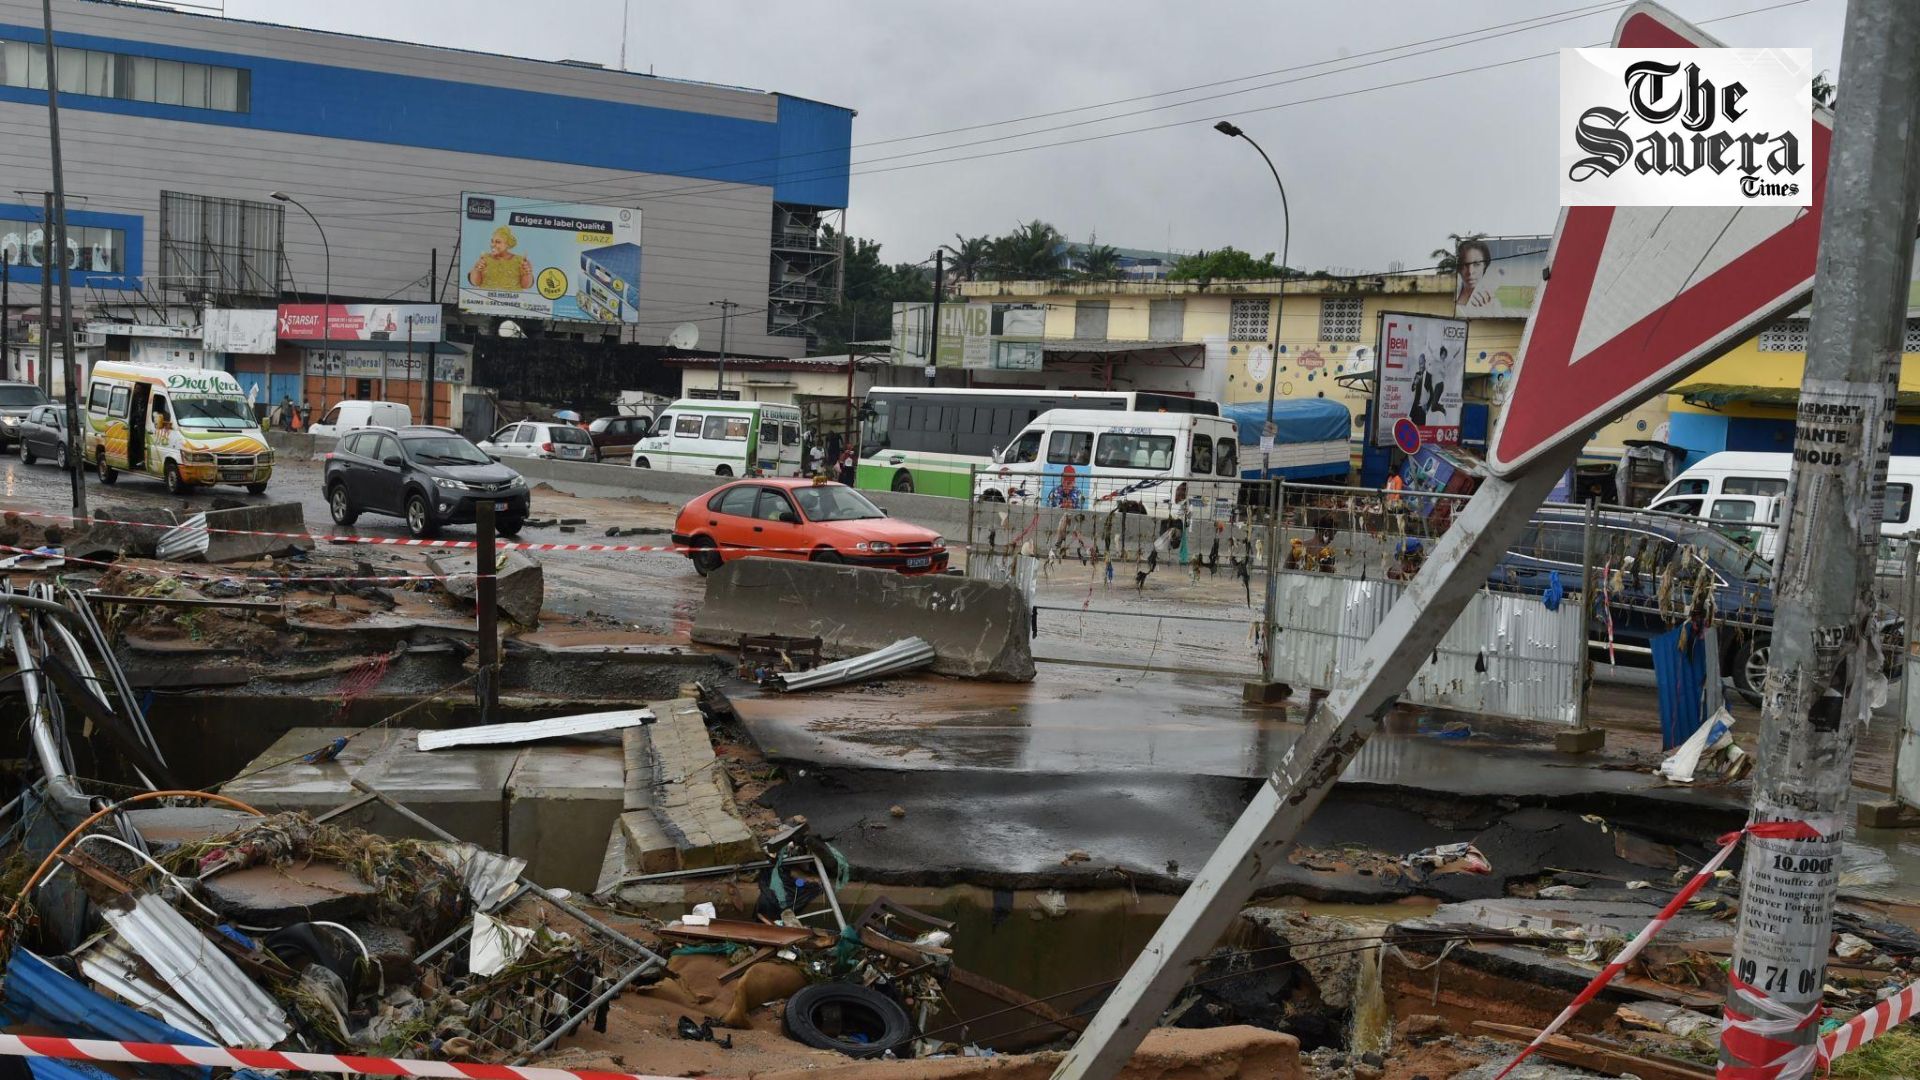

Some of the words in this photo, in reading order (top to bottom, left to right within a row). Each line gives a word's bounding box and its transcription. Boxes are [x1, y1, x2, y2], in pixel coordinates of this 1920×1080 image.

[515, 216, 543, 226] Exigez
[544, 217, 552, 226] le
[553, 219, 574, 228] label
[575, 221, 606, 231] Qualité
[582, 234, 610, 244] DJAZZ
[287, 314, 320, 326] STARSAT
[941, 307, 988, 337] HMB
[1443, 326, 1465, 339] KEDGE
[168, 374, 210, 394] Dieu
[1773, 854, 1834, 873] 10.000F
[1774, 873, 1813, 887] souffrez
[1767, 911, 1793, 924] votre
[1738, 957, 1757, 985] 09
[1765, 965, 1788, 993] 74
